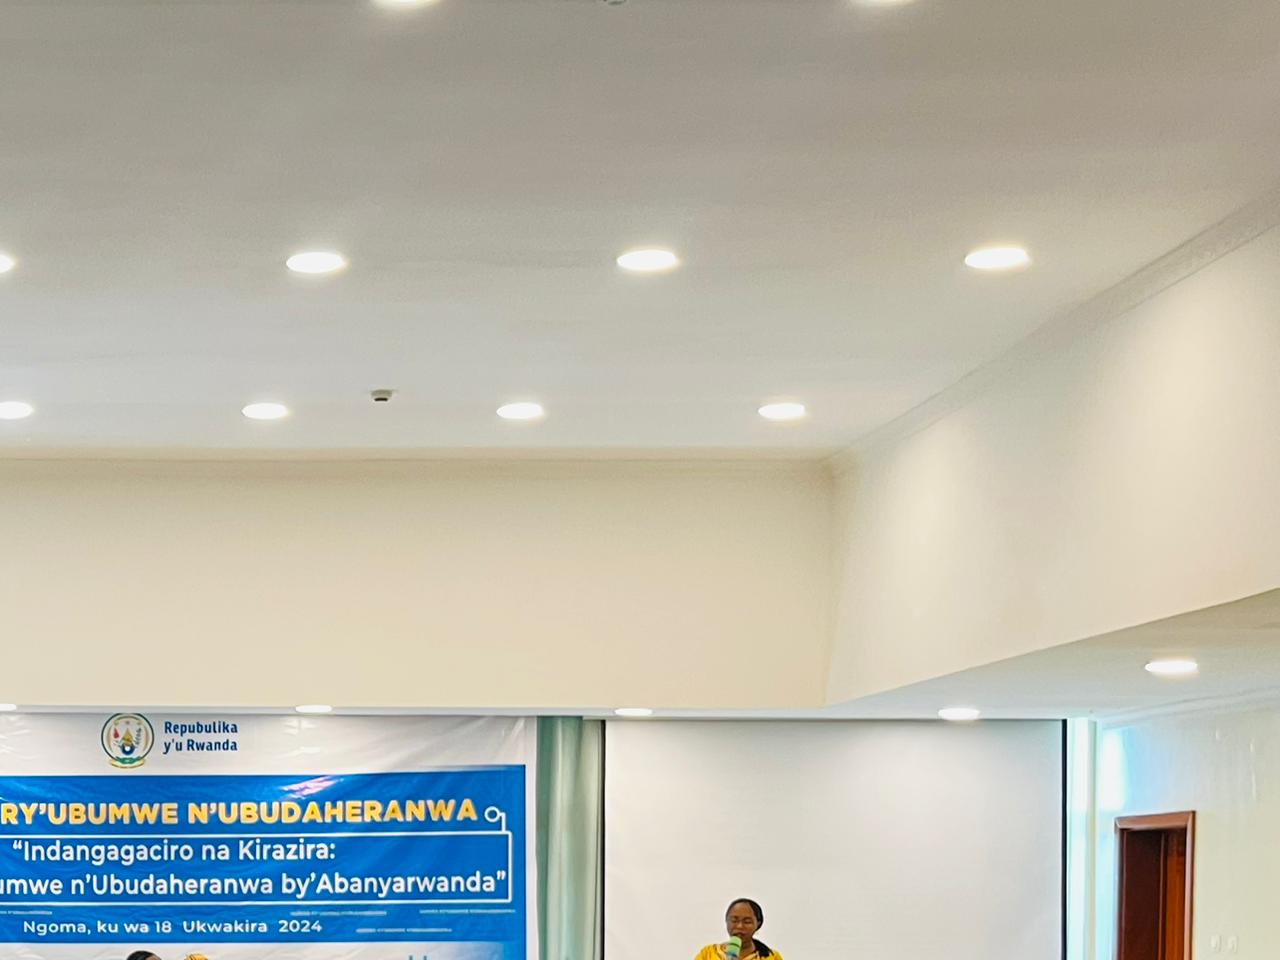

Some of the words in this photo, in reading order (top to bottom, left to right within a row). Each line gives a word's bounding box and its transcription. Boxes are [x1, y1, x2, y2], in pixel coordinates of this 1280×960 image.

[164, 721, 238, 736] Repubulika
[163, 739, 183, 754] y'u
[186, 739, 238, 751] Rwanda
[0, 801, 178, 825] RY’UBUMWE
[187, 799, 478, 824] N’UBUDAHERANWA
[12, 839, 193, 865] “Indangagaciro
[201, 843, 230, 861] na
[238, 838, 336, 861] Kirazira:
[71, 872, 273, 895] n’Ubudaheranwa
[23, 920, 91, 936] Ngoma,
[97, 920, 119, 933] ku
[123, 922, 150, 933] wa
[155, 920, 172, 933] 18
[183, 919, 268, 933] Ukwakira
[278, 920, 322, 933] 2024
